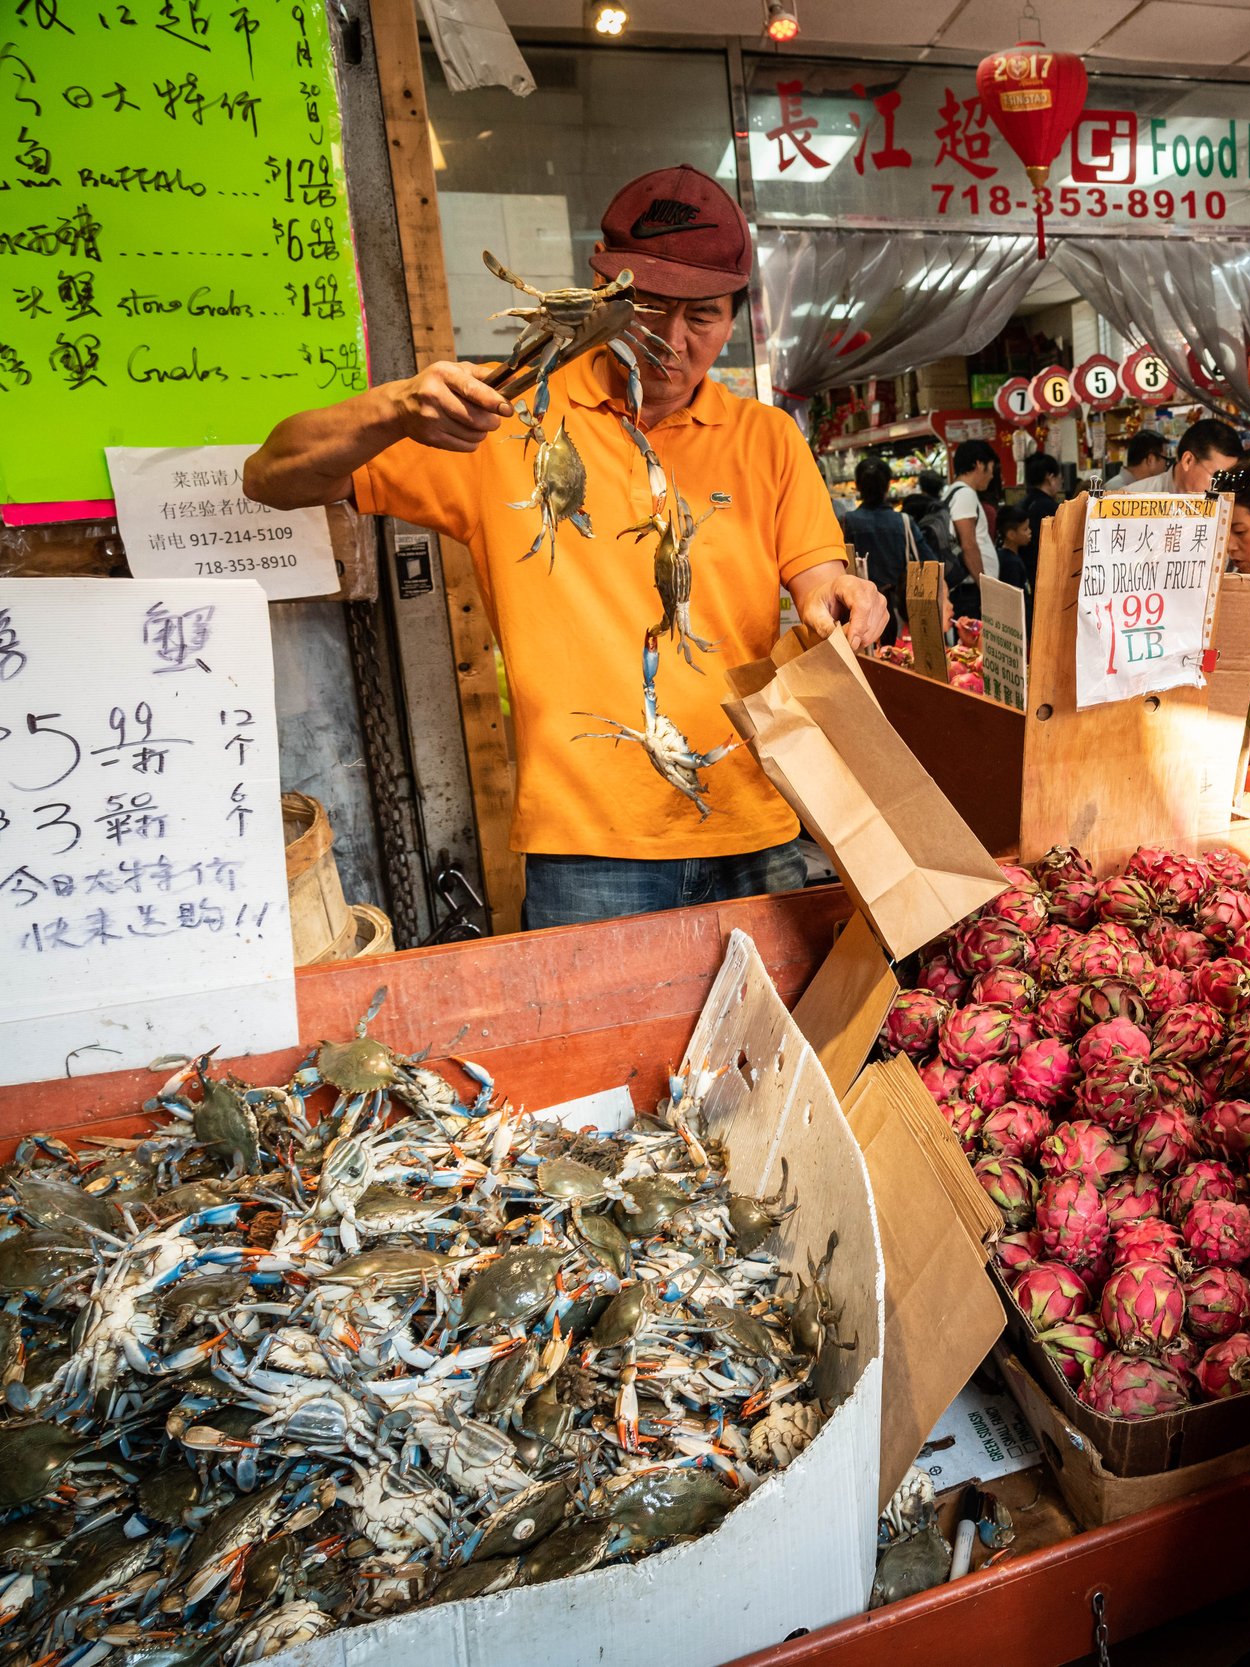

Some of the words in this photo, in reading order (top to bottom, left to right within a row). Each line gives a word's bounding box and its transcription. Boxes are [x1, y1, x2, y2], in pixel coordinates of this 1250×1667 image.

[994, 54, 1053, 81] 2017
[766, 80, 1062, 181] 長江超
[1151, 117, 1238, 180] Food
[642, 199, 700, 225] NIKE
[931, 184, 1227, 220] 718-353-8910
[1095, 371, 1107, 394] 5
[1144, 361, 1159, 387] 3
[1015, 391, 1027, 412] 7
[1052, 381, 1065, 403] 6
[1111, 499, 1212, 518] SUPERMARKET
[148, 532, 186, 551] 请电
[189, 526, 294, 547] 917-214-5109
[1086, 523, 1209, 557] 紅肉火龍果
[194, 553, 298, 576] 718-353-8910
[1084, 565, 1106, 597] RED
[1112, 561, 1160, 594] DRAGON
[1163, 559, 1206, 590] FRUIT
[1124, 631, 1165, 663] LB
[106, 792, 152, 811] 50
[967, 1411, 991, 1440] SQUASH
[994, 1424, 1015, 1448] SMALL
[982, 1436, 1005, 1463] GREEN
